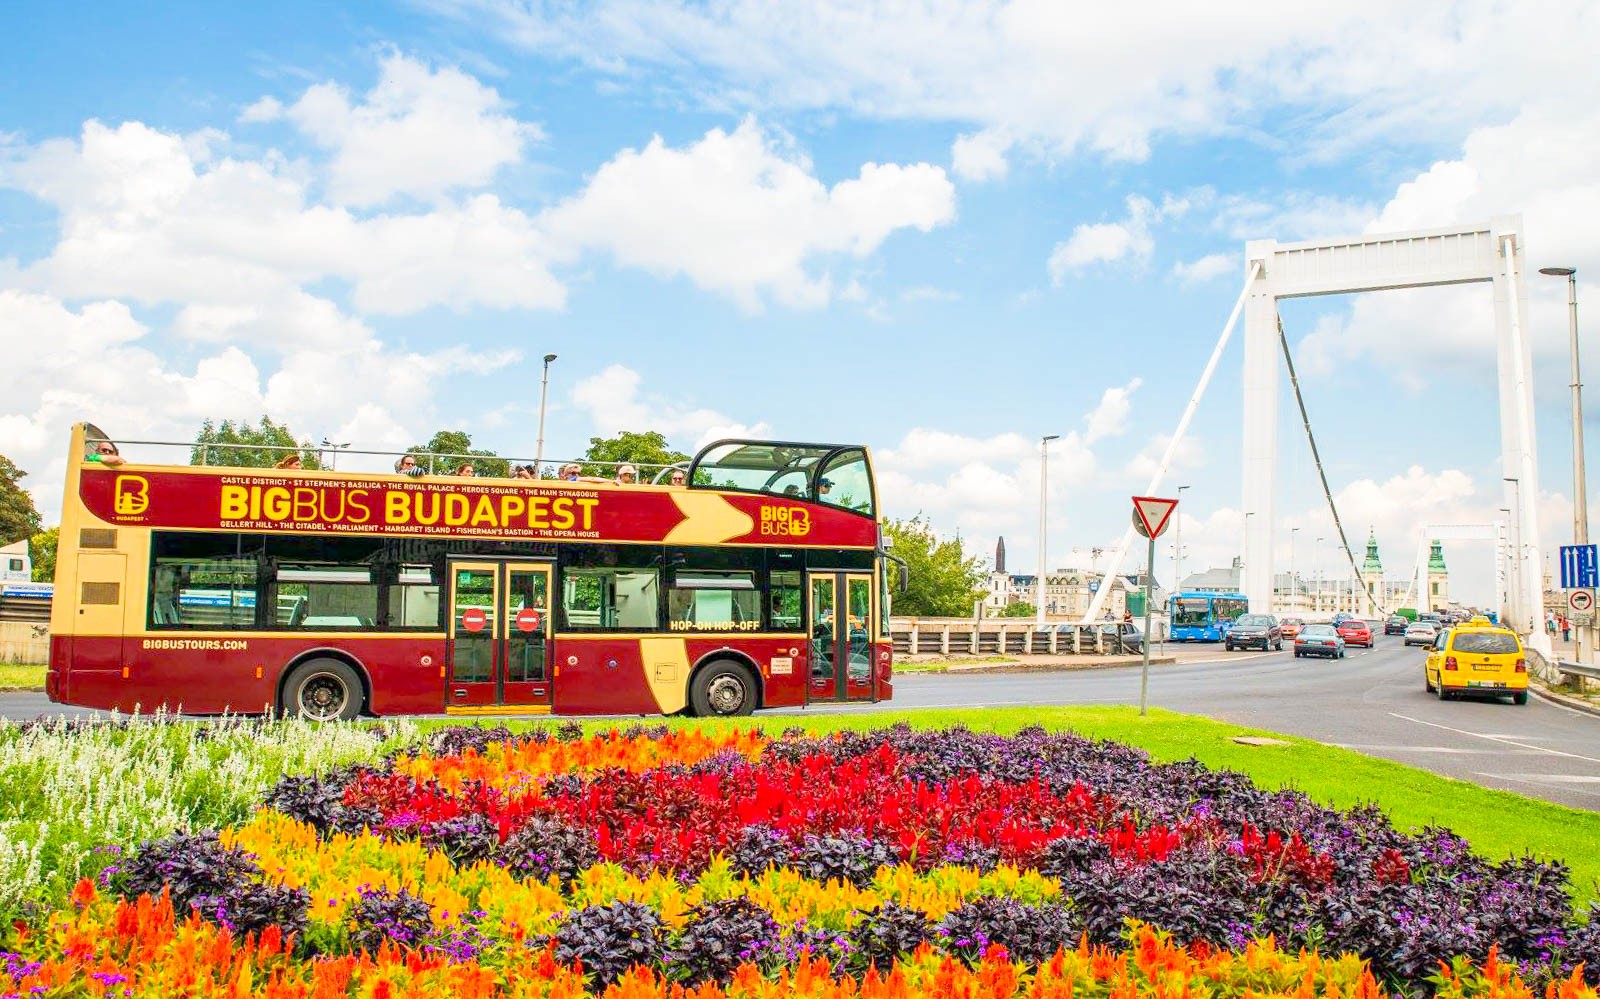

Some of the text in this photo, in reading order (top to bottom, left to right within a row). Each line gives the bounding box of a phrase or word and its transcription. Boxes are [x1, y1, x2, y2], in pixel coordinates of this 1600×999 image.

[305, 480, 346, 488] STEPHEN'S
[559, 490, 599, 498] SYNAGOGUE
[385, 491, 600, 530] BUDAPEST
[761, 506, 788, 521] BIG
[425, 526, 451, 534] ISLAND
[456, 527, 503, 535] FISHERMAN'S
[761, 522, 789, 535] BUS
[143, 640, 247, 650] BIGBUSTOURS.COM
